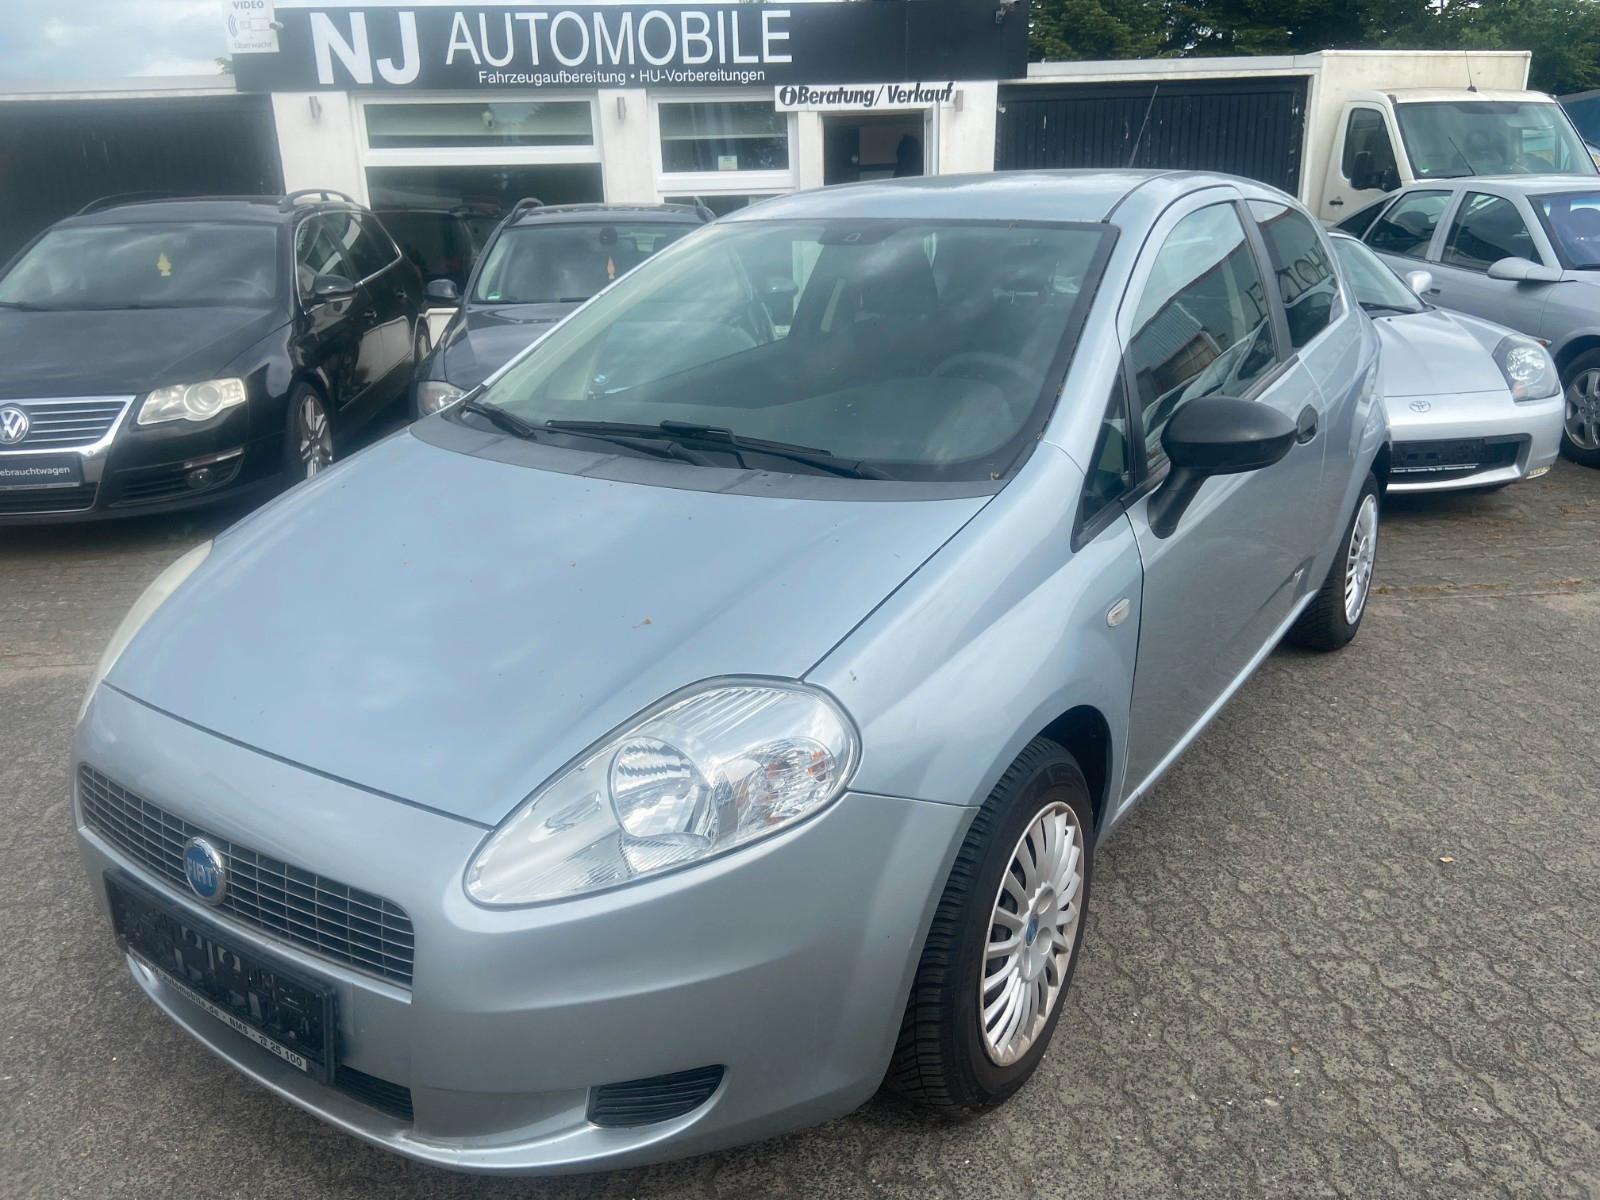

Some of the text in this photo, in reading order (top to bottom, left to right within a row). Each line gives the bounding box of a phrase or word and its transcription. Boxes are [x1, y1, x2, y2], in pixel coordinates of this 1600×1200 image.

[232, 0, 265, 9] VIDEO
[309, 9, 793, 86] NJ AUTOMOBILE
[478, 68, 766, 87] Fahrzeugaufbereitung HU-Vorbereitungen
[888, 81, 954, 105] Verkauf
[0, 466, 70, 476] ebrauchtwagen
[186, 856, 214, 887] FIAT
